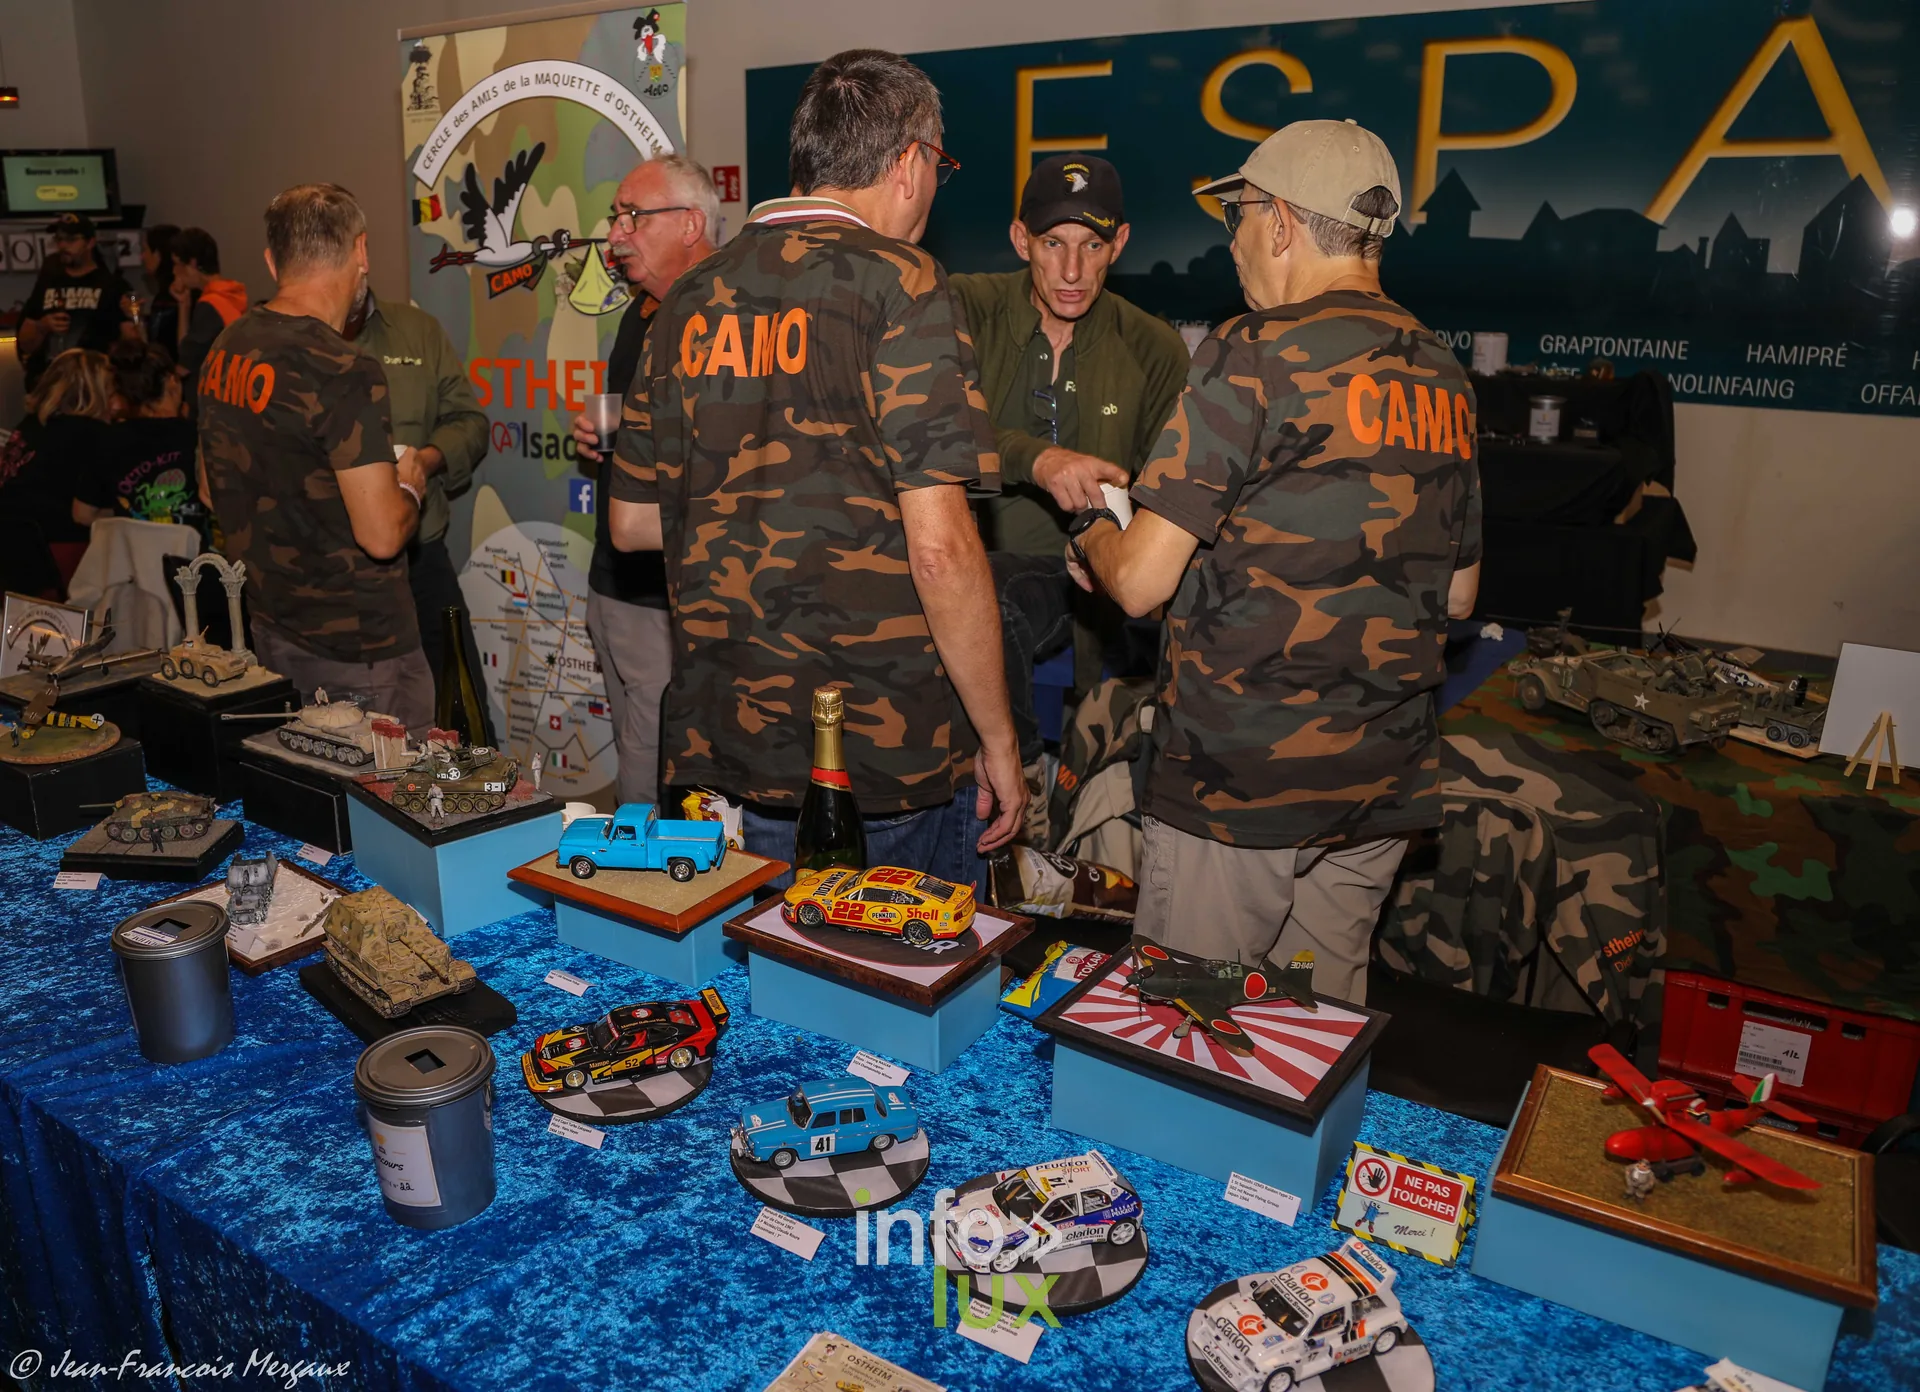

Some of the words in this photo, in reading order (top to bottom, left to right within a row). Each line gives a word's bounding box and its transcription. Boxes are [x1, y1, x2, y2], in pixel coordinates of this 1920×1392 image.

[422, 126, 452, 169] CERCLE
[453, 109, 470, 129] des
[471, 86, 499, 113] AMIS
[503, 79, 517, 92] de
[520, 75, 530, 87] la
[534, 72, 601, 97] MAQUETTE
[490, 263, 533, 293] CAMO
[681, 307, 808, 378] CAMO
[1540, 334, 1689, 360] GRAPTONTAINE
[1747, 341, 1849, 368] HAMIPRÉ
[198, 350, 276, 414] AMO
[1101, 402, 1118, 416] ab
[1347, 373, 1472, 460] CAMO
[867, 868, 917, 885] 22
[832, 901, 866, 921] 22
[872, 911, 898, 920] PENNZOIL
[906, 907, 939, 921] Shell
[625, 1058, 639, 1068] 52
[815, 1136, 831, 1153] 41
[1036, 1160, 1089, 1171] PEUGEOT
[1404, 1174, 1423, 1190] NE
[1425, 1179, 1451, 1198] PAS
[1392, 1187, 1456, 1217] TOUCHER
[1394, 1224, 1427, 1237] Merci
[1361, 1249, 1387, 1274] Clarion
[1278, 1272, 1315, 1308] Clarion
[1215, 1316, 1250, 1356] Clarion
[847, 1354, 893, 1381] OSTHEIM
[1203, 1345, 1215, 1359] CAR
[1214, 1355, 1233, 1379] STEREO
